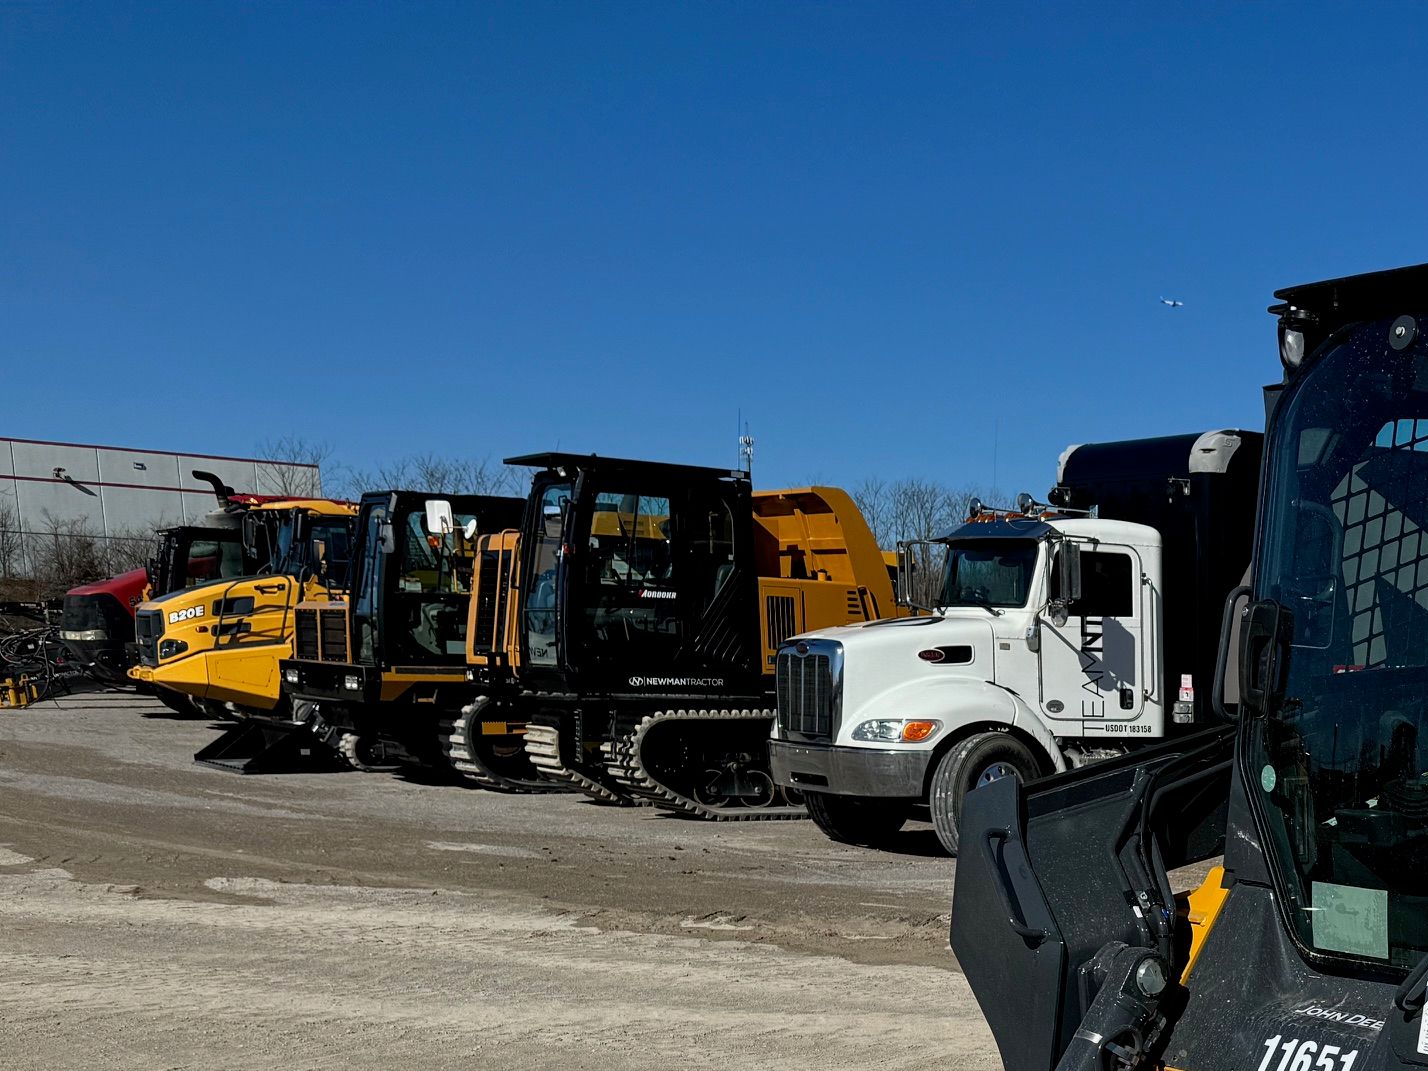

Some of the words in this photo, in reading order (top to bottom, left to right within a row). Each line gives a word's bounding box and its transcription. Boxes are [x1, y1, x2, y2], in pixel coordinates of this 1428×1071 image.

[168, 605, 205, 624] B20E
[1105, 724, 1128, 733] USDOT
[1295, 1005, 1346, 1021] JOHN
[1345, 1014, 1385, 1030] DEE
